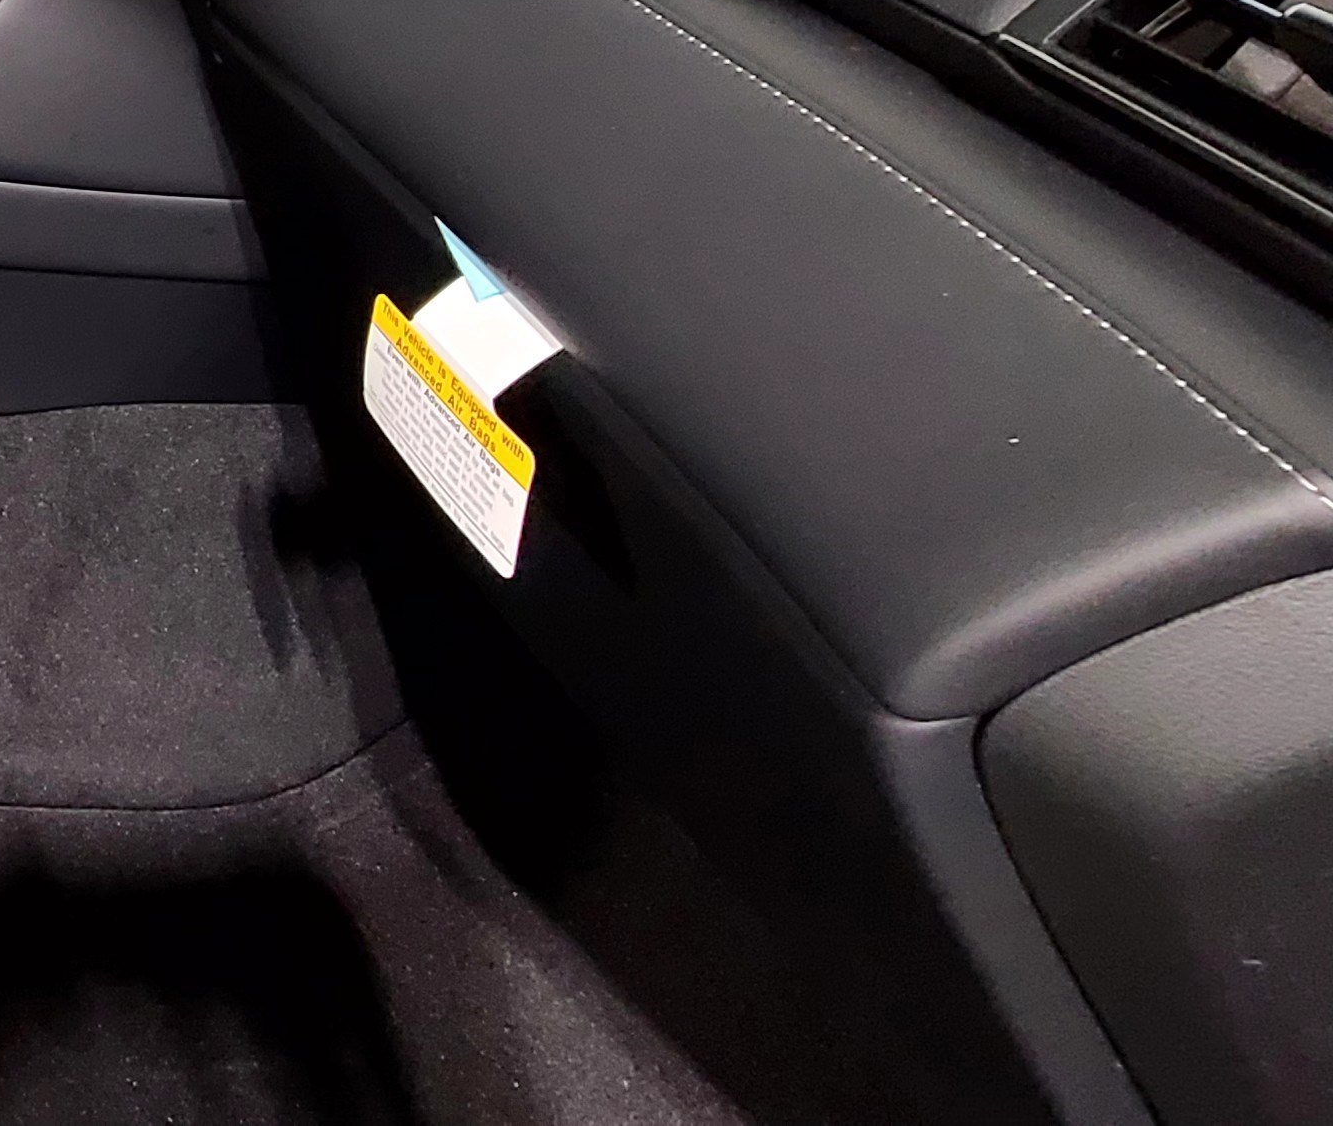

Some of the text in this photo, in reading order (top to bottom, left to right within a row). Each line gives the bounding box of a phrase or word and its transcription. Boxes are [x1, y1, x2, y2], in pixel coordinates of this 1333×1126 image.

[383, 301, 399, 328] This
[404, 324, 434, 365] Vehicle
[451, 377, 497, 433] Equipped
[502, 433, 525, 462] with
[396, 337, 496, 453] Advanced Air Bags
[424, 388, 461, 433] Advanced
[464, 433, 476, 449] Air
